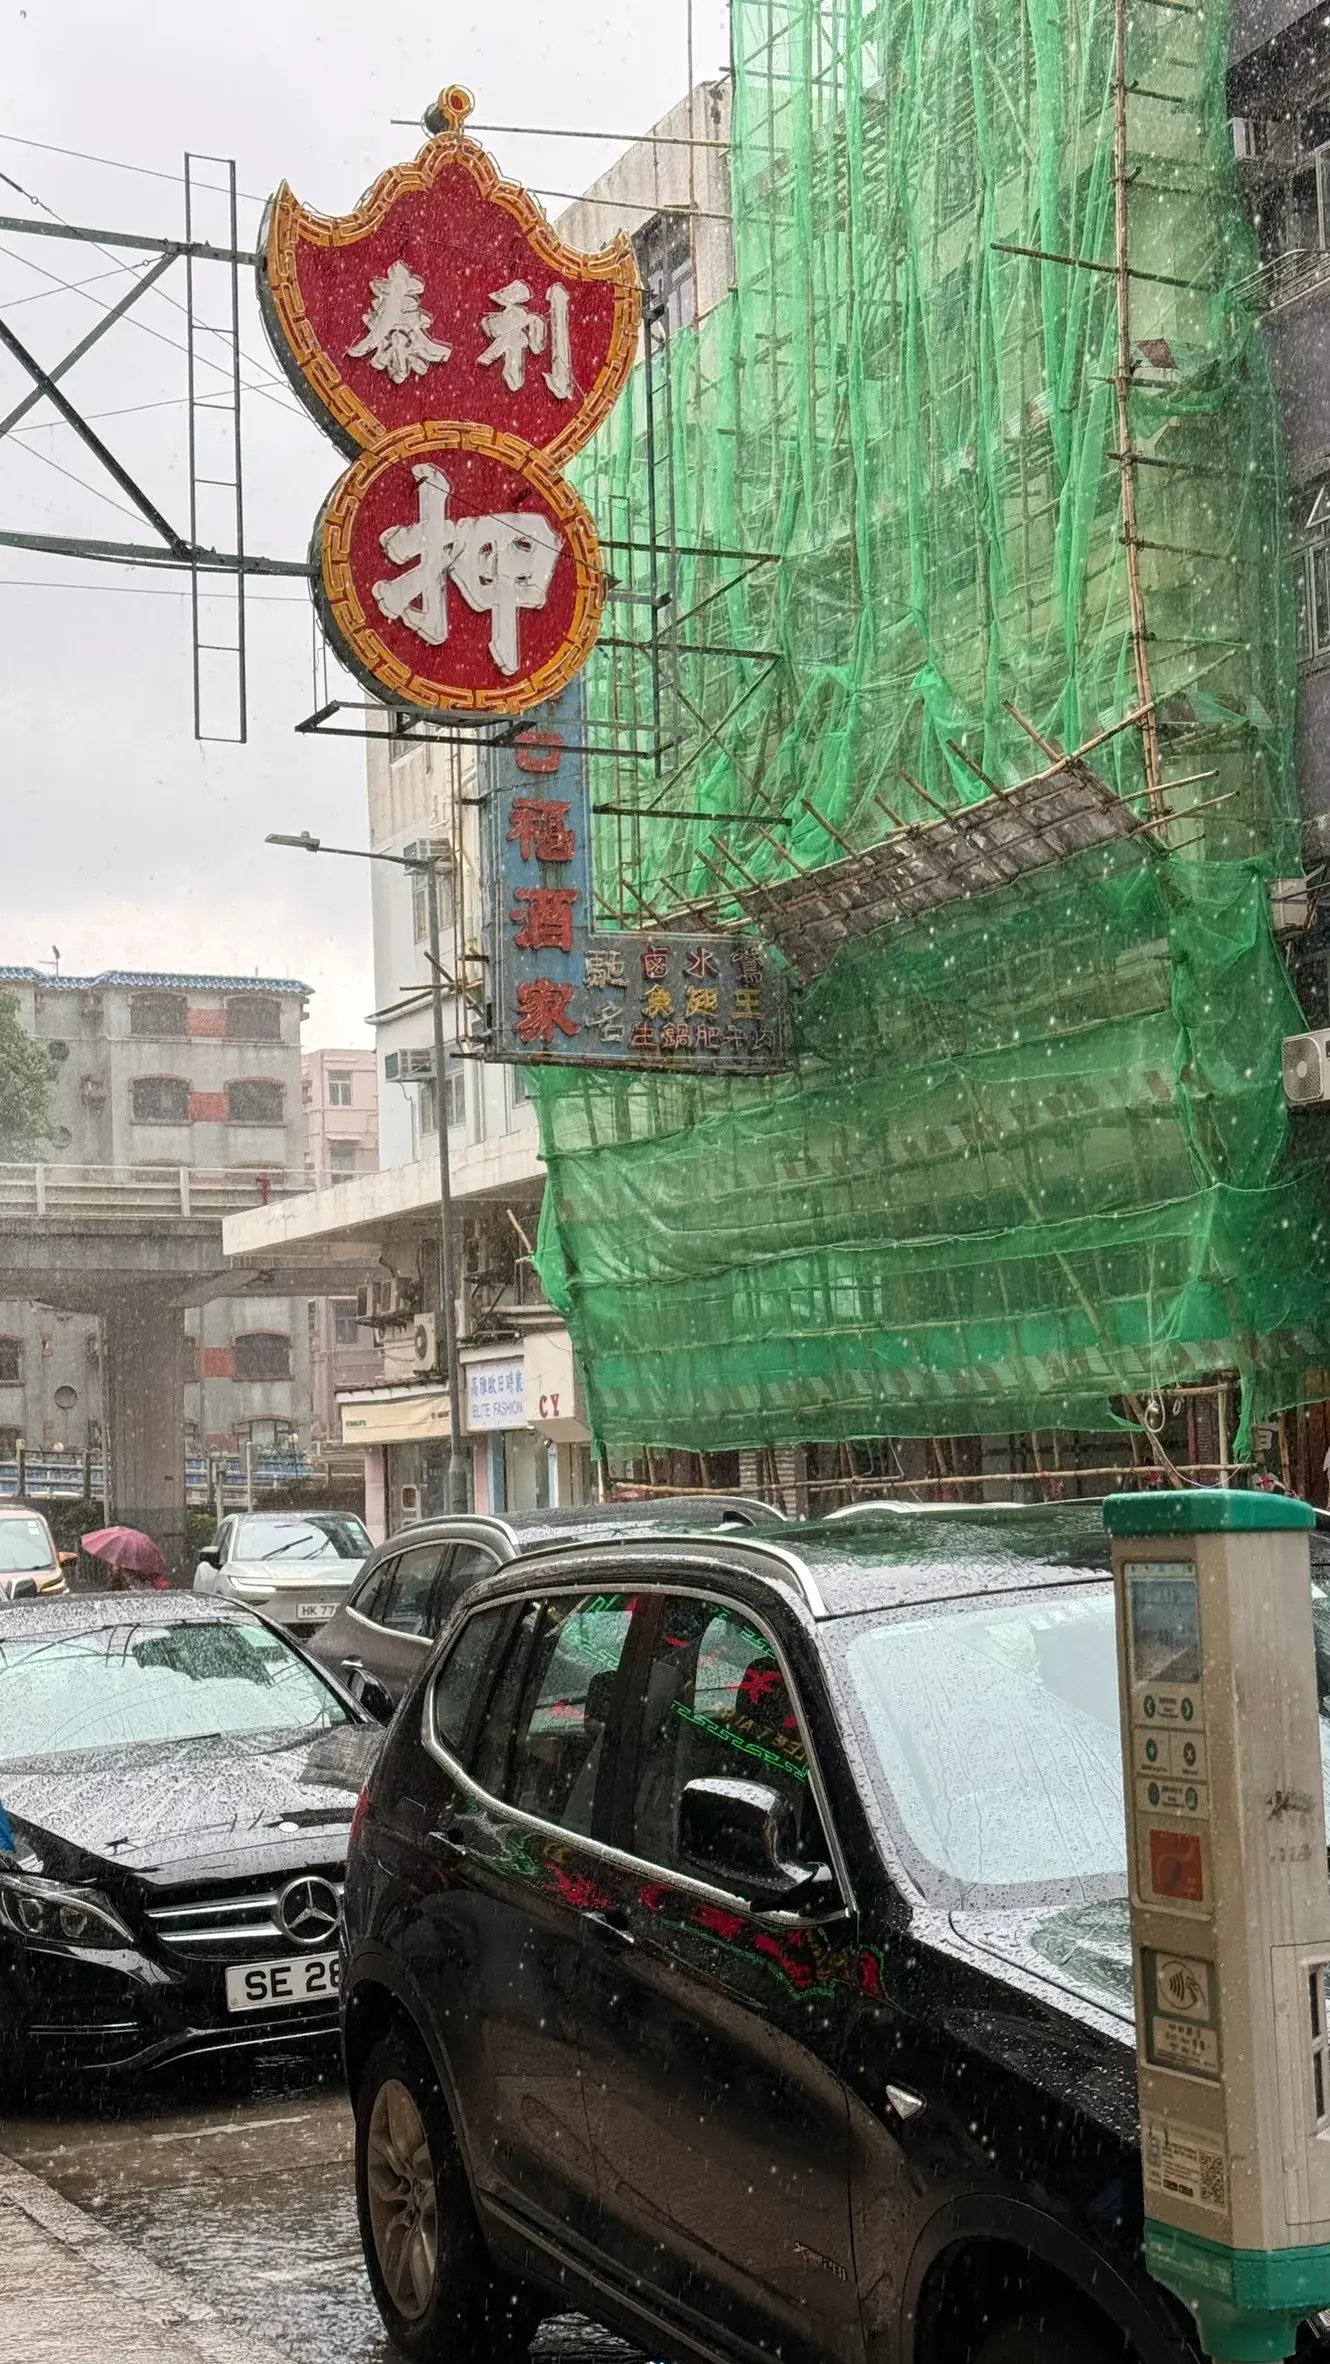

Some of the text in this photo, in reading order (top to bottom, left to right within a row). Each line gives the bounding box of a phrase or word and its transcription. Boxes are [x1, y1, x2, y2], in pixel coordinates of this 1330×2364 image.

[371, 462, 565, 677] 押
[505, 731, 582, 1044] 口福酒家
[472, 1400, 523, 1418] ELITE FASHION
[539, 1393, 559, 1418] CY
[302, 1605, 317, 1615] HK
[245, 1958, 340, 2001] SE 28
